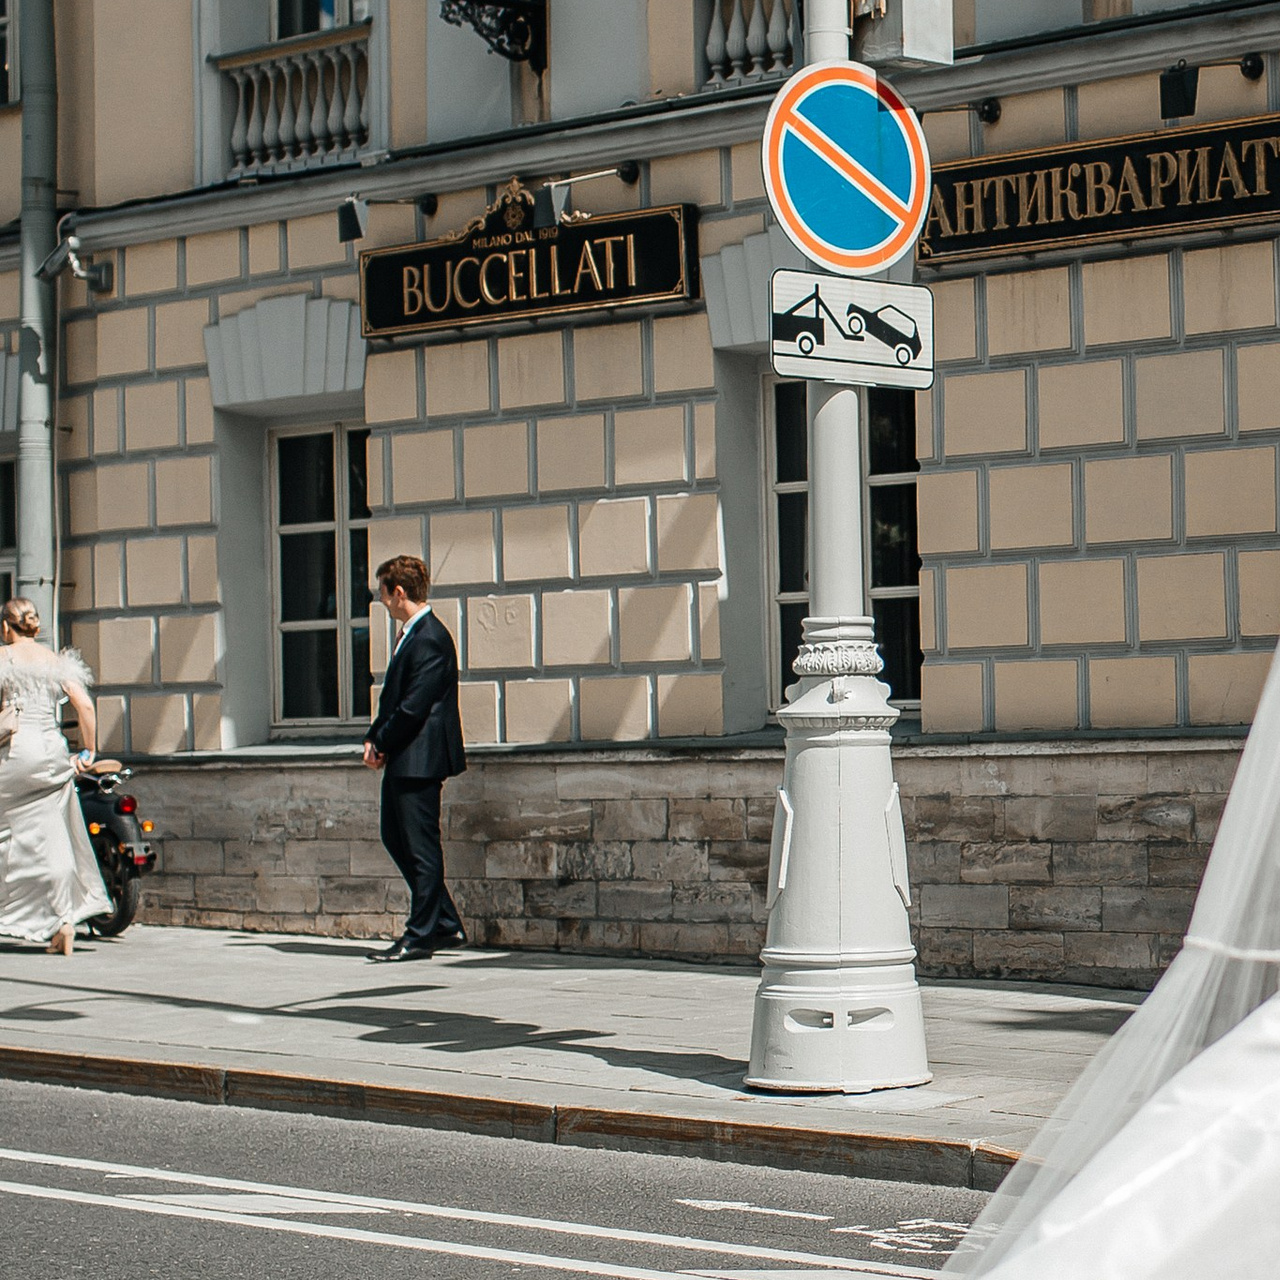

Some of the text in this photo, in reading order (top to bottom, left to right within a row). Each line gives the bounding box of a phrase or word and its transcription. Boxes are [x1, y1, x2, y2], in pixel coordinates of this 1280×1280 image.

[472, 226, 559, 249] MILANO DAL 1919
[403, 234, 636, 316] BUCCELLATI
